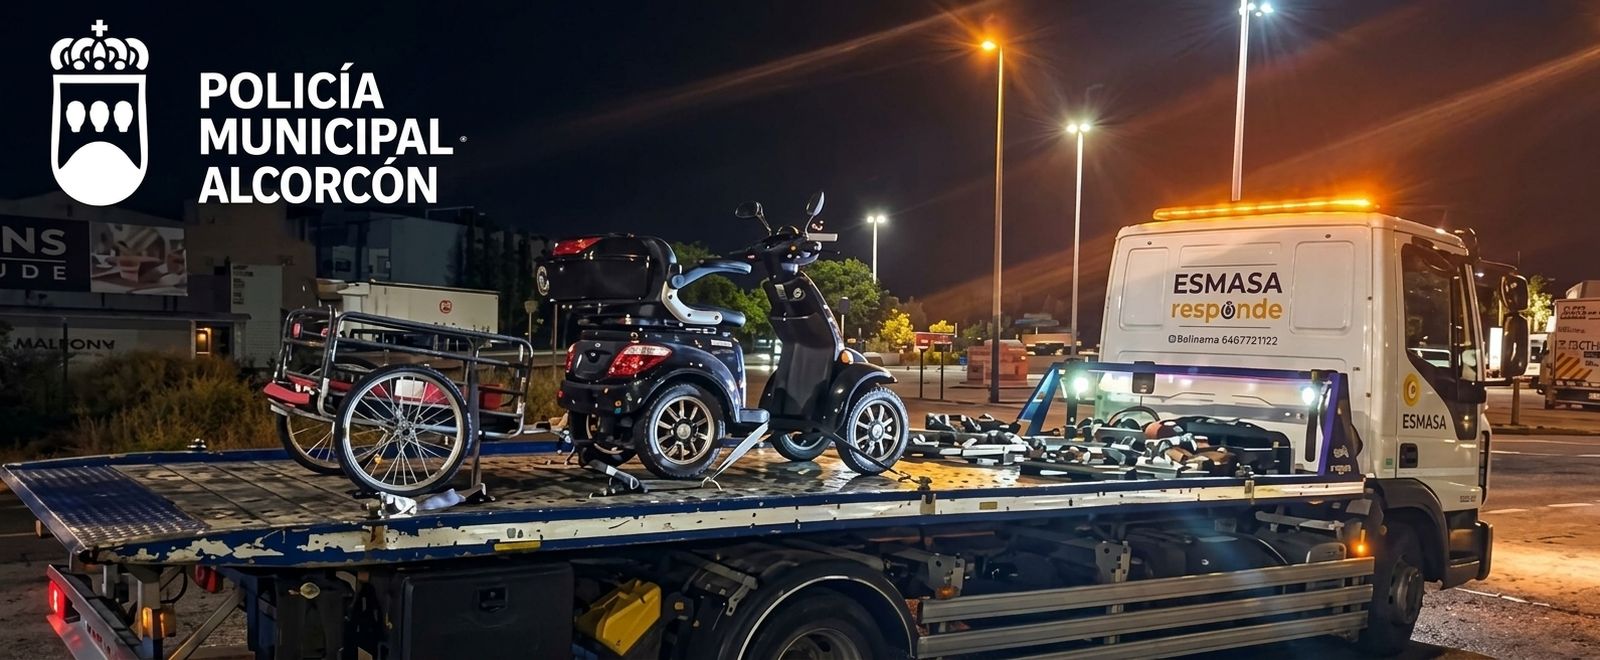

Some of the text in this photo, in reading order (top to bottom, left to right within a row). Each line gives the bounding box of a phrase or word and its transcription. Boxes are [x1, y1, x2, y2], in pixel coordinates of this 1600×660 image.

[1173, 272, 1282, 294] ESMASA
[1171, 298, 1283, 323] responde
[1402, 414, 1447, 430] ESMASA
